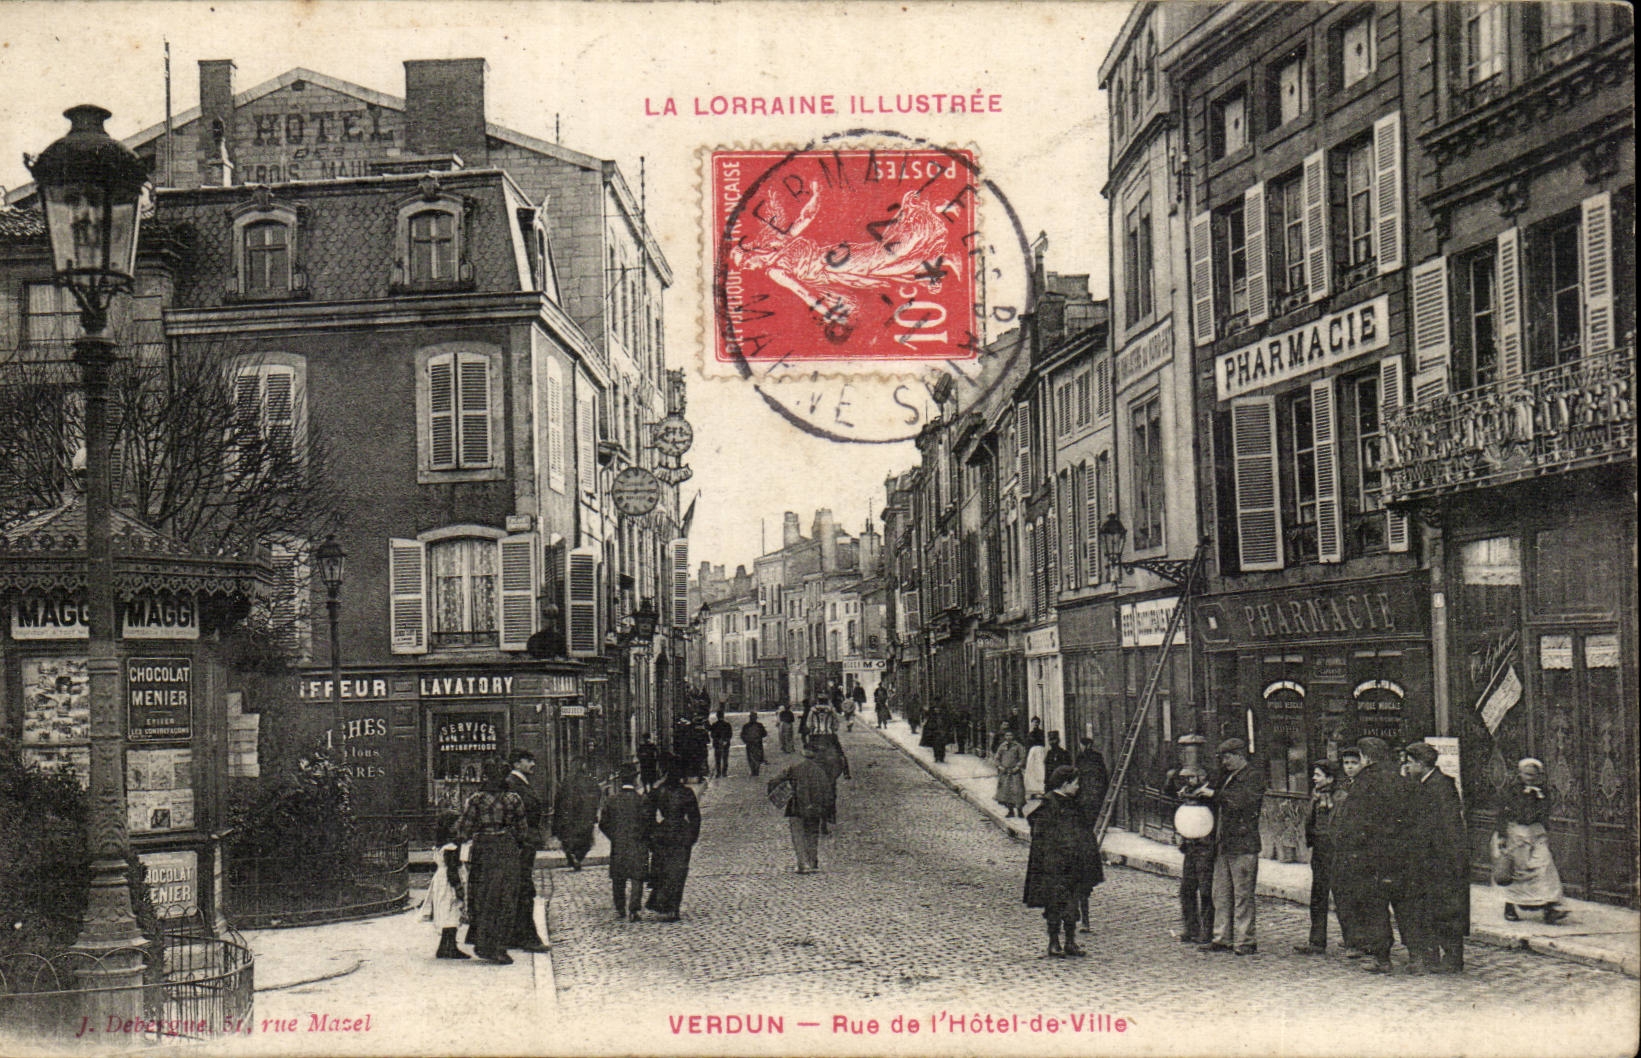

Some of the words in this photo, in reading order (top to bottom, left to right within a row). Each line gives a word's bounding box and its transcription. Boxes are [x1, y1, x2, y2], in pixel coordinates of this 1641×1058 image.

[873, 160, 957, 181] POSTES
[1223, 304, 1378, 391] PHARMACIE
[126, 600, 196, 628] MAGGI
[1244, 592, 1396, 637] PHARMACIE
[129, 666, 190, 683] CHOCOLAT
[420, 676, 513, 696] LAVATORY
[132, 690, 188, 706] MENIER
[441, 722, 496, 735] SERVICE
